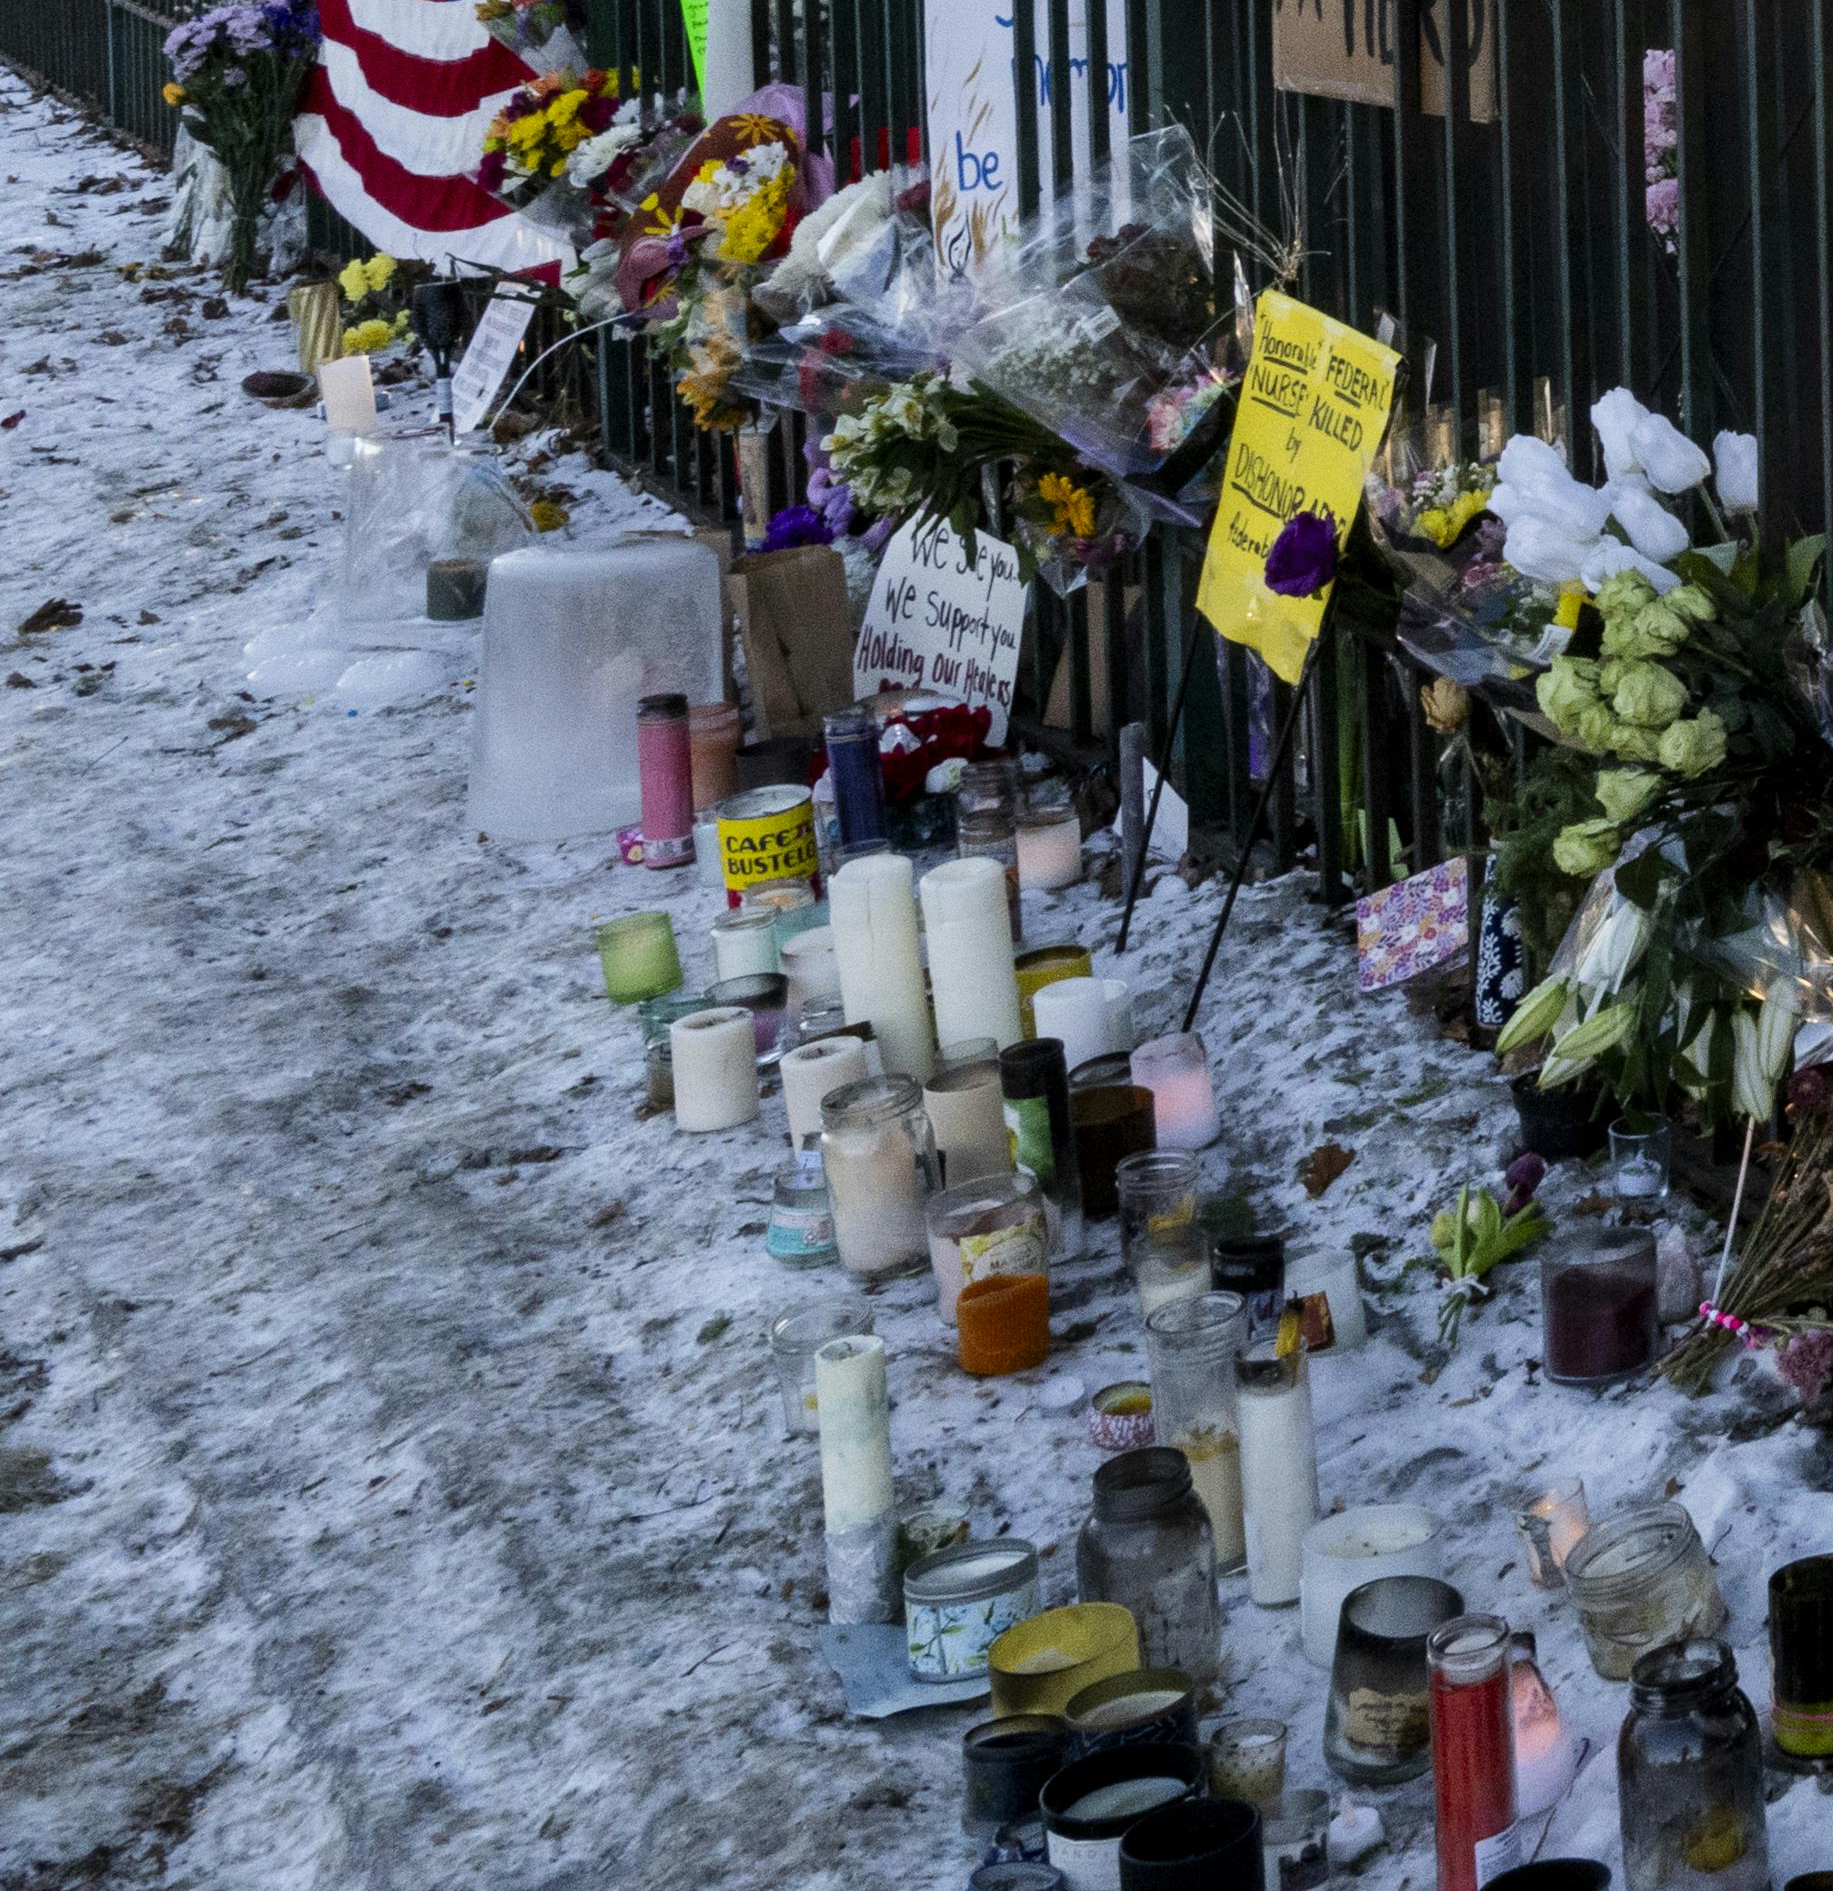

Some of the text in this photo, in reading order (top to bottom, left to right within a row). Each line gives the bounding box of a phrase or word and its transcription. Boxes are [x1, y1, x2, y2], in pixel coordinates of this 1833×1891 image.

[956, 130, 1003, 192] be
[1285, 427, 1302, 463] by
[1308, 395, 1363, 452] KILLED
[911, 517, 950, 570] We
[886, 576, 916, 623] We
[992, 623, 1016, 662] you
[727, 838, 817, 876] BUSTELO
